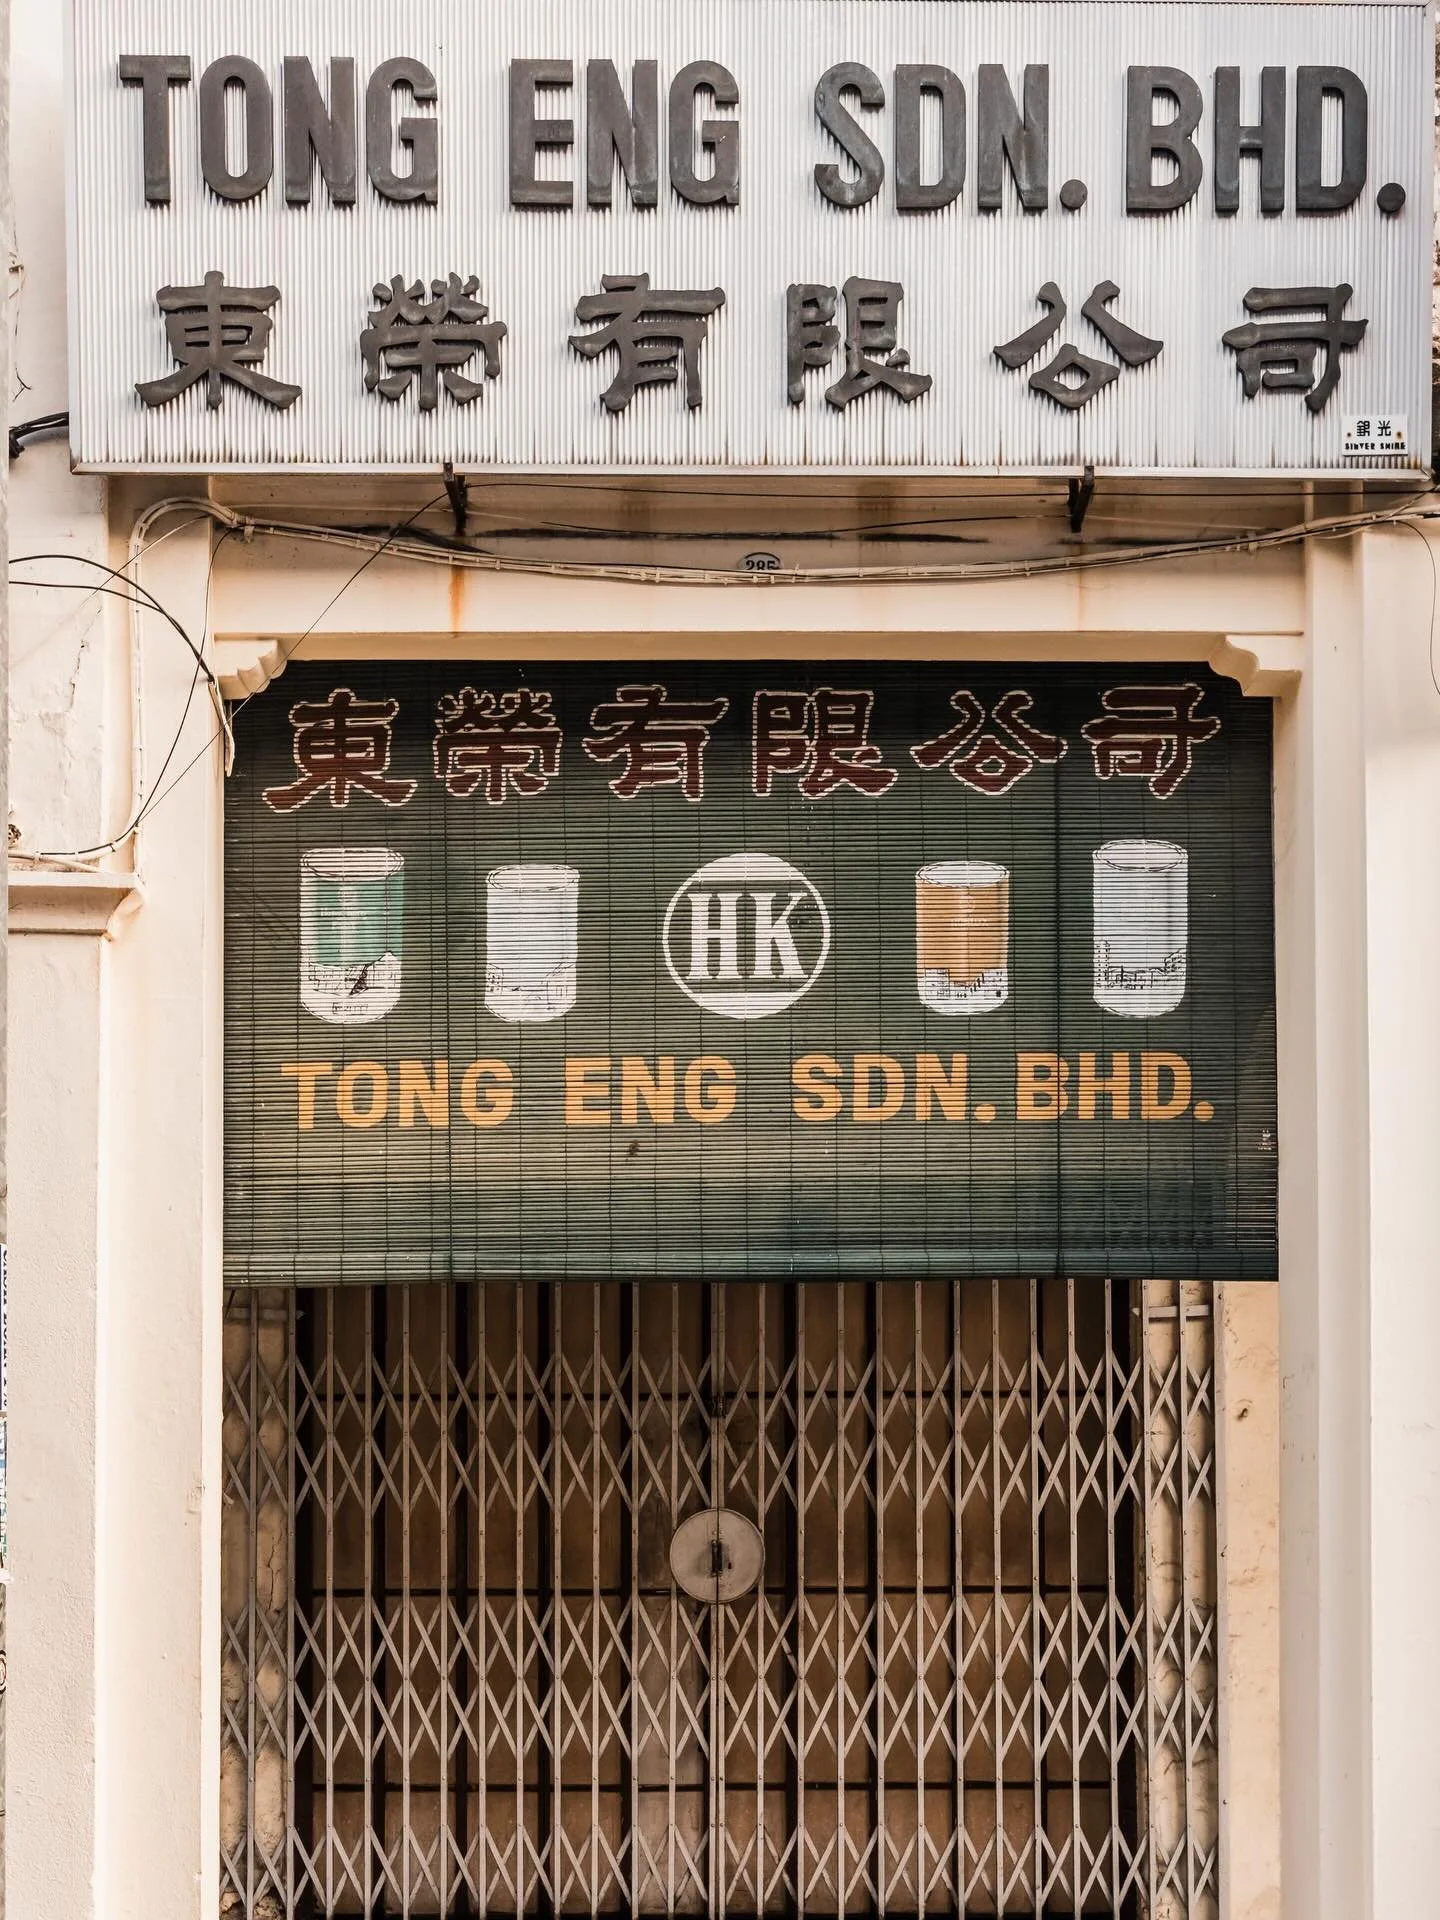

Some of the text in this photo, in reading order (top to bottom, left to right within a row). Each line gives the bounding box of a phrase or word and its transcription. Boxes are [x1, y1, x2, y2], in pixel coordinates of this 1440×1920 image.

[119, 55, 1407, 214] TONG ENG SDN. BHD.
[134, 269, 1369, 412] 東榮有限公司
[1356, 420, 1392, 437] 銀光
[261, 684, 1222, 813] 東榮有限公司
[685, 891, 809, 981] HK
[281, 1051, 1216, 1131] TONG ENG SDN. BHD.
